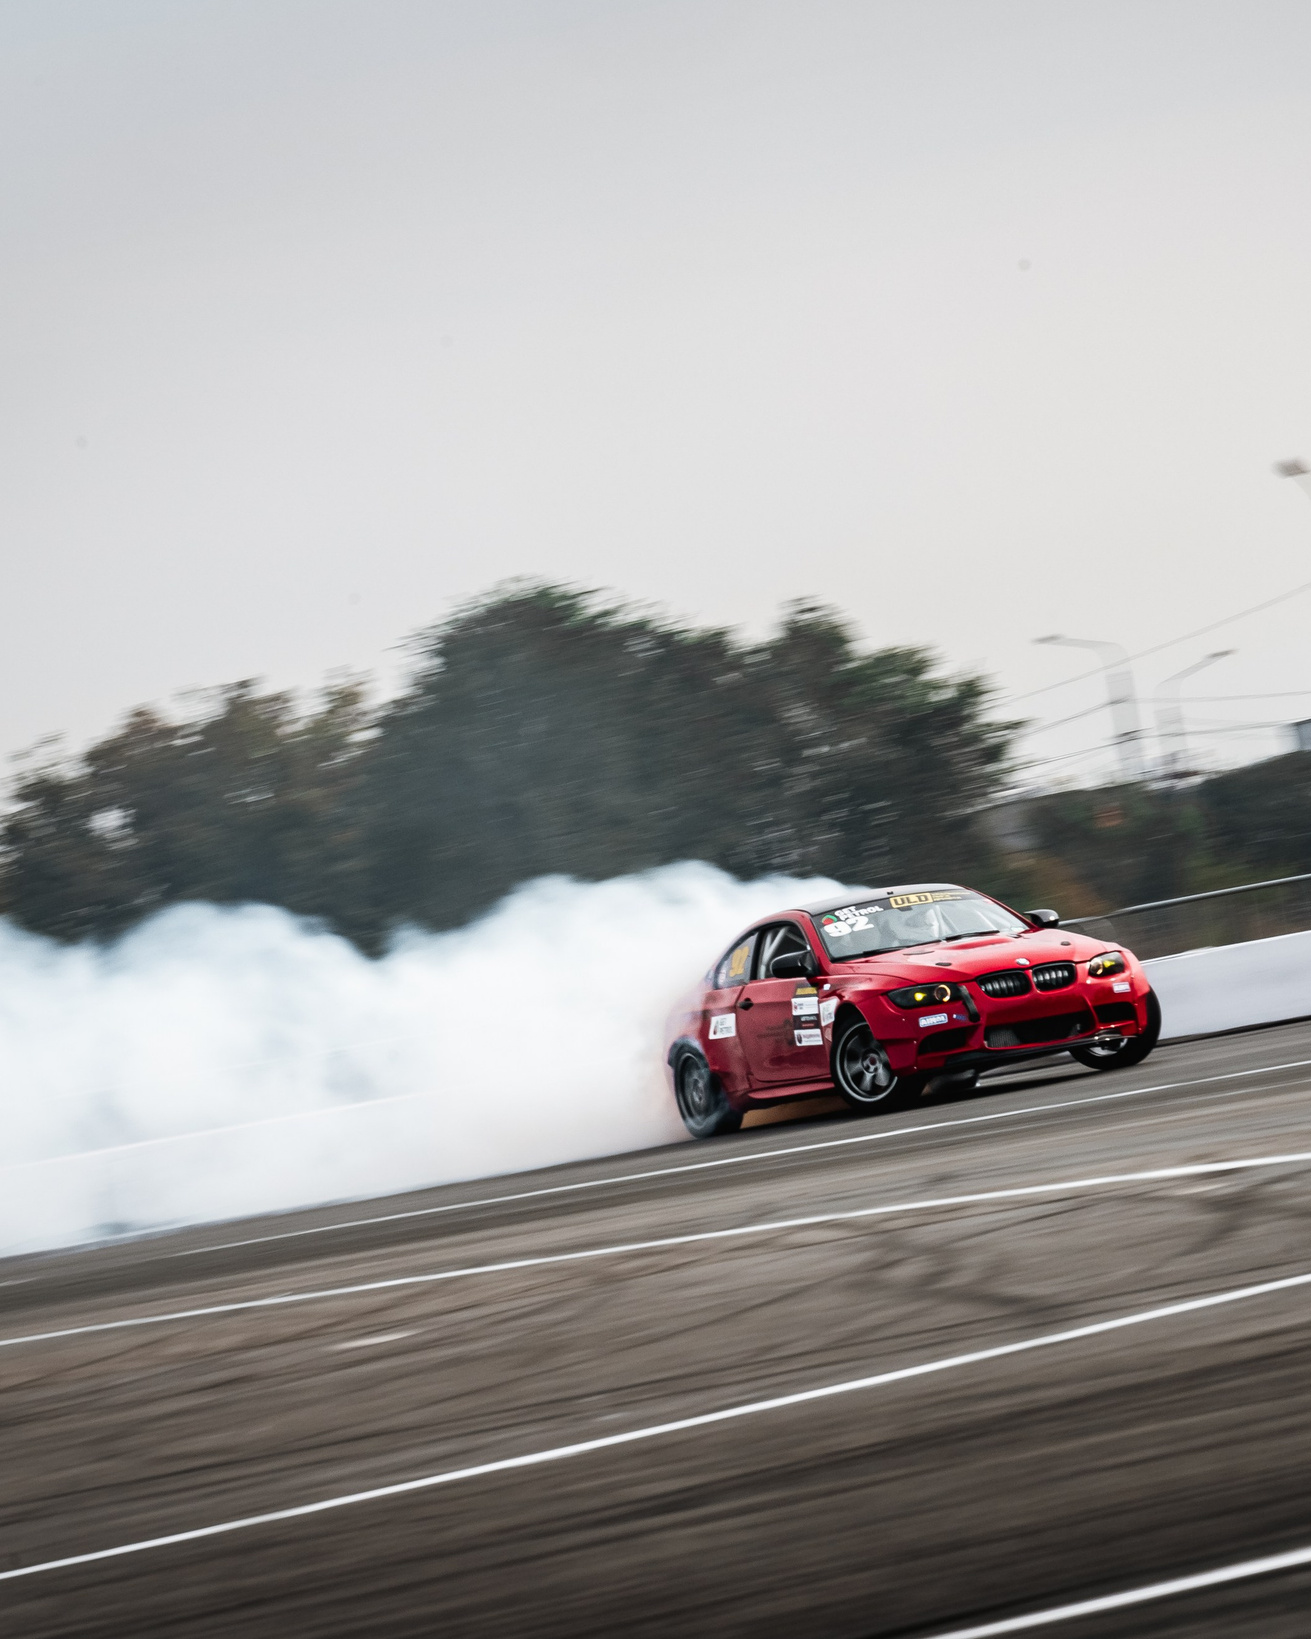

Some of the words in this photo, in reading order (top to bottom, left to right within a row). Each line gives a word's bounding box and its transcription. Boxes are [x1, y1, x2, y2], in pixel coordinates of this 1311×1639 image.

[893, 894, 929, 906] ULD
[834, 906, 856, 917] GET
[839, 905, 884, 920] PETROL
[823, 915, 874, 937] 92
